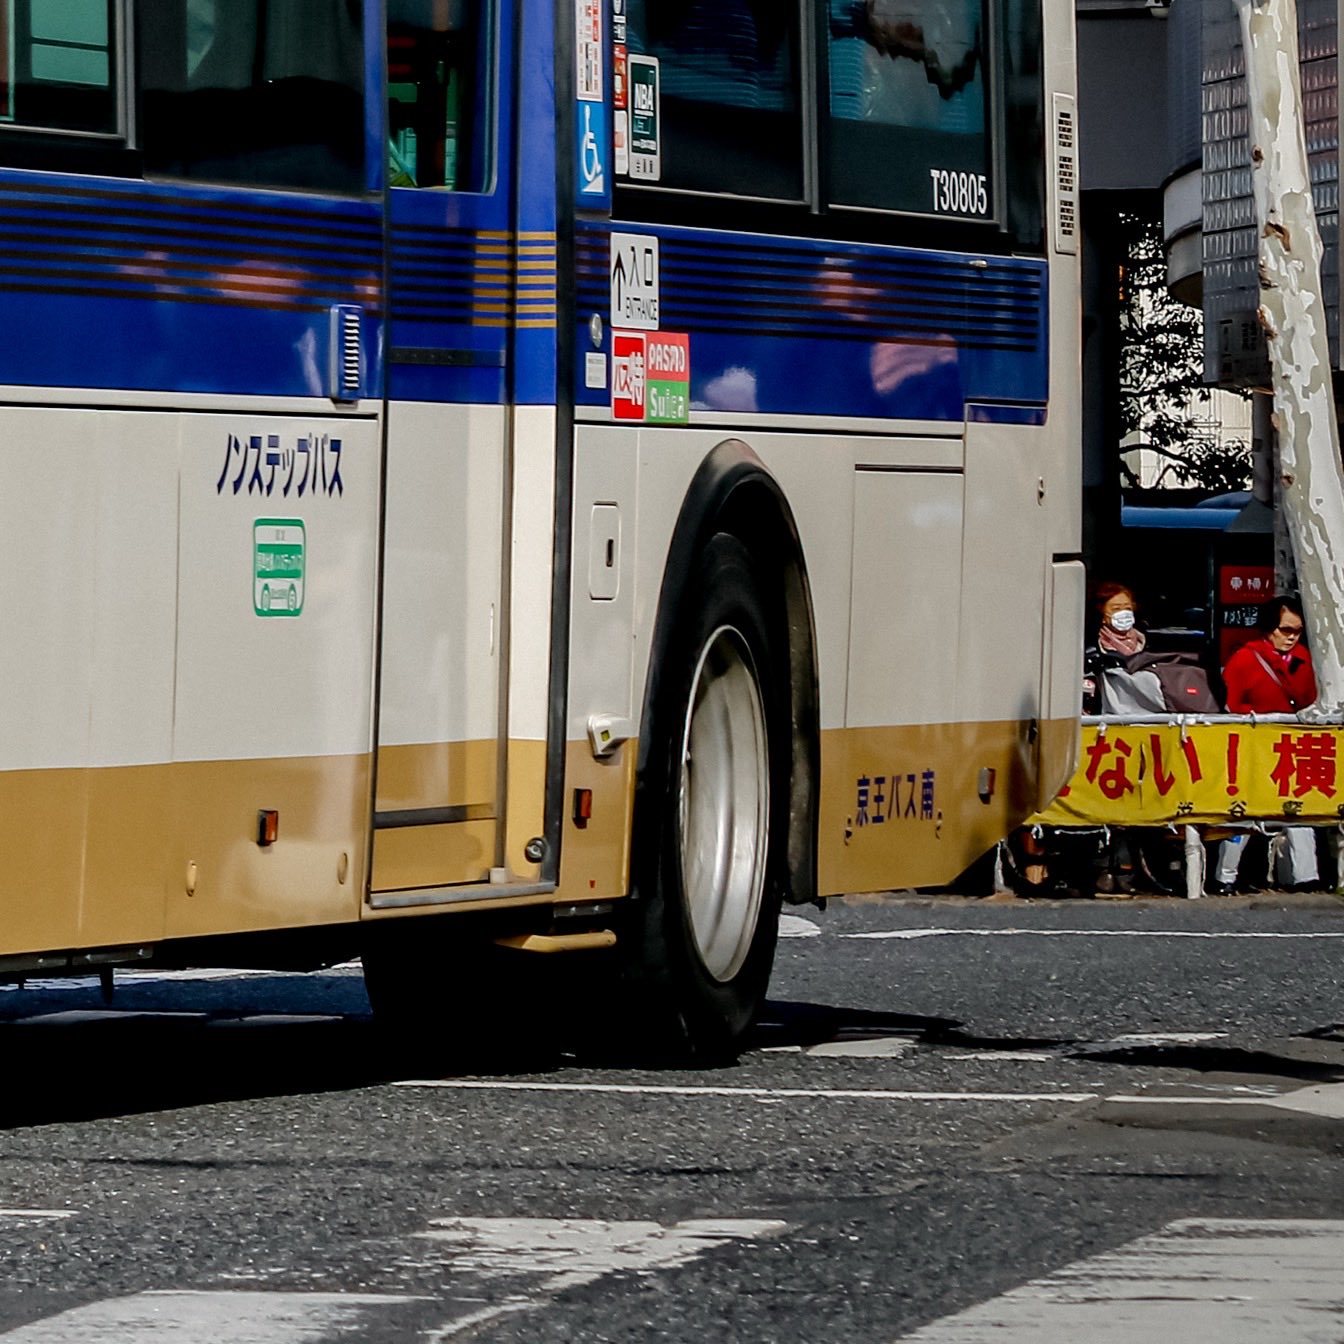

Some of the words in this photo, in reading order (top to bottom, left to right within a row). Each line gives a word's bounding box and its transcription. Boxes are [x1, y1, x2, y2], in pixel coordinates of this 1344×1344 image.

[930, 169, 987, 215] T30805
[628, 246, 654, 288] 入口
[625, 297, 658, 321] ENTRANCE
[648, 342, 686, 373] PASMO
[650, 387, 685, 419] Suica
[216, 432, 344, 498] ノンステップバス
[1058, 732, 1337, 800] ない！横
[855, 767, 934, 827] 京王バス南
